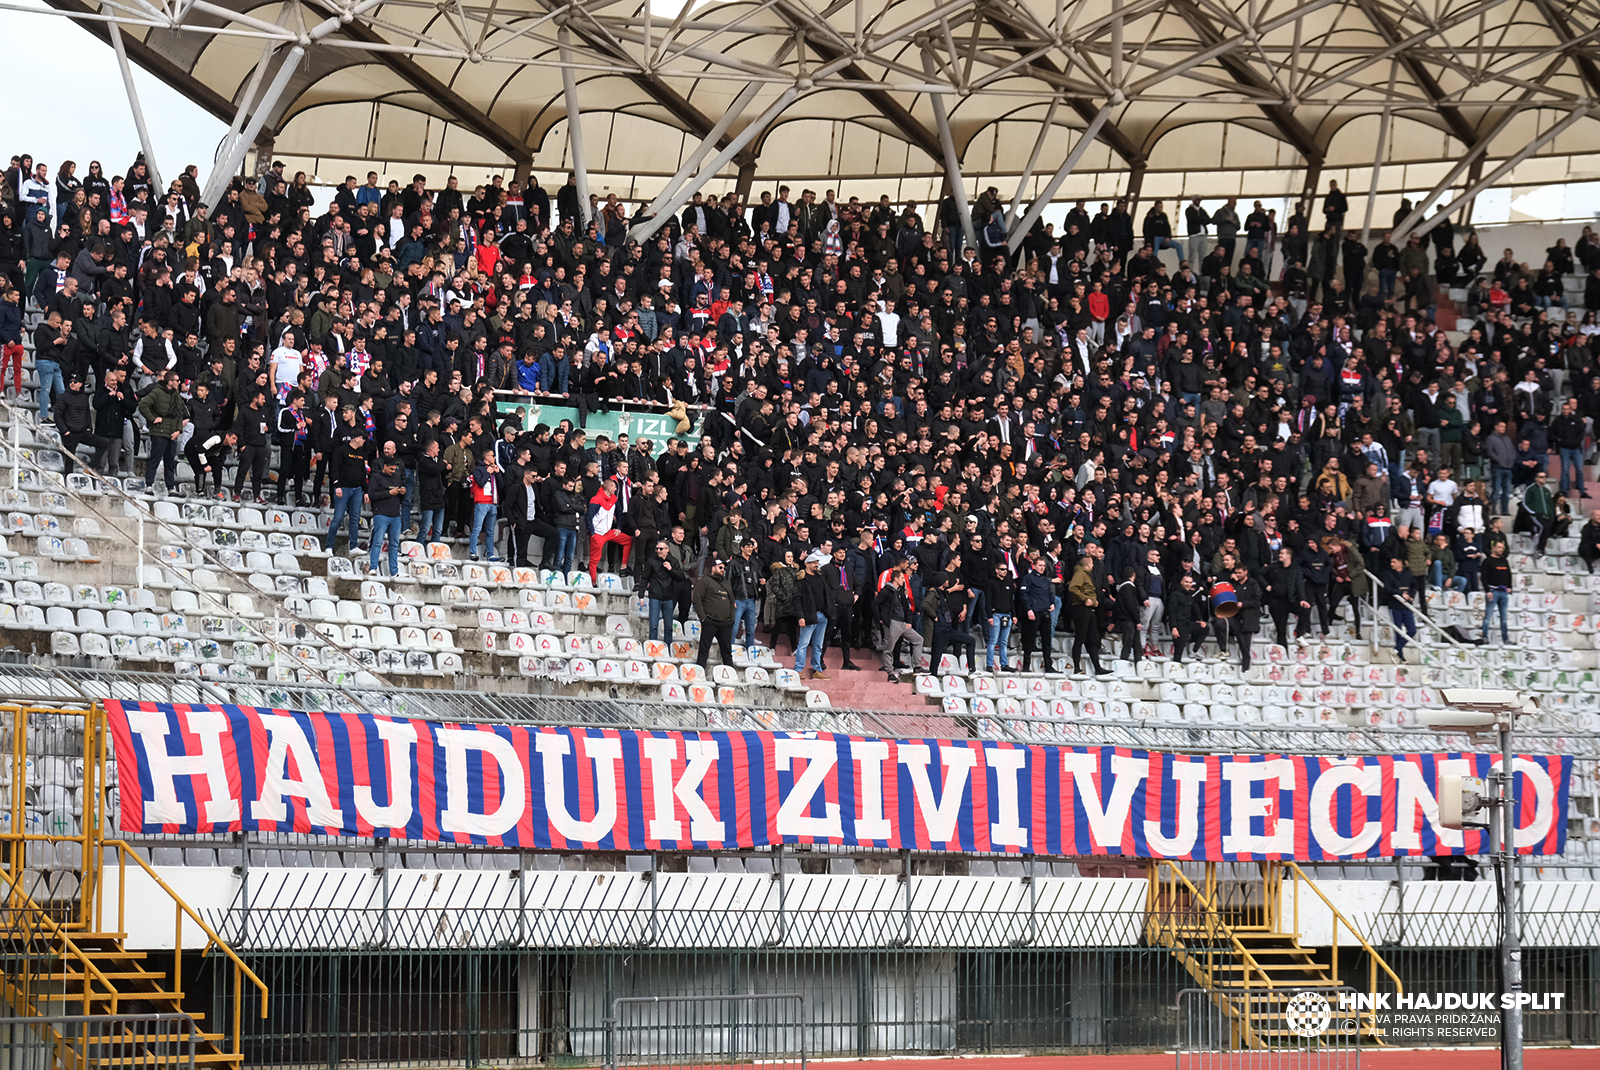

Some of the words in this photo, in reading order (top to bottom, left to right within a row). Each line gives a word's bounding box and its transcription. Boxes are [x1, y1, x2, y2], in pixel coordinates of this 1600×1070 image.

[636, 418, 702, 438] IZLZ
[126, 710, 726, 844] HAJDUK
[774, 732, 1028, 848] ŽIVI
[1063, 753, 1554, 857] VJEČNO
